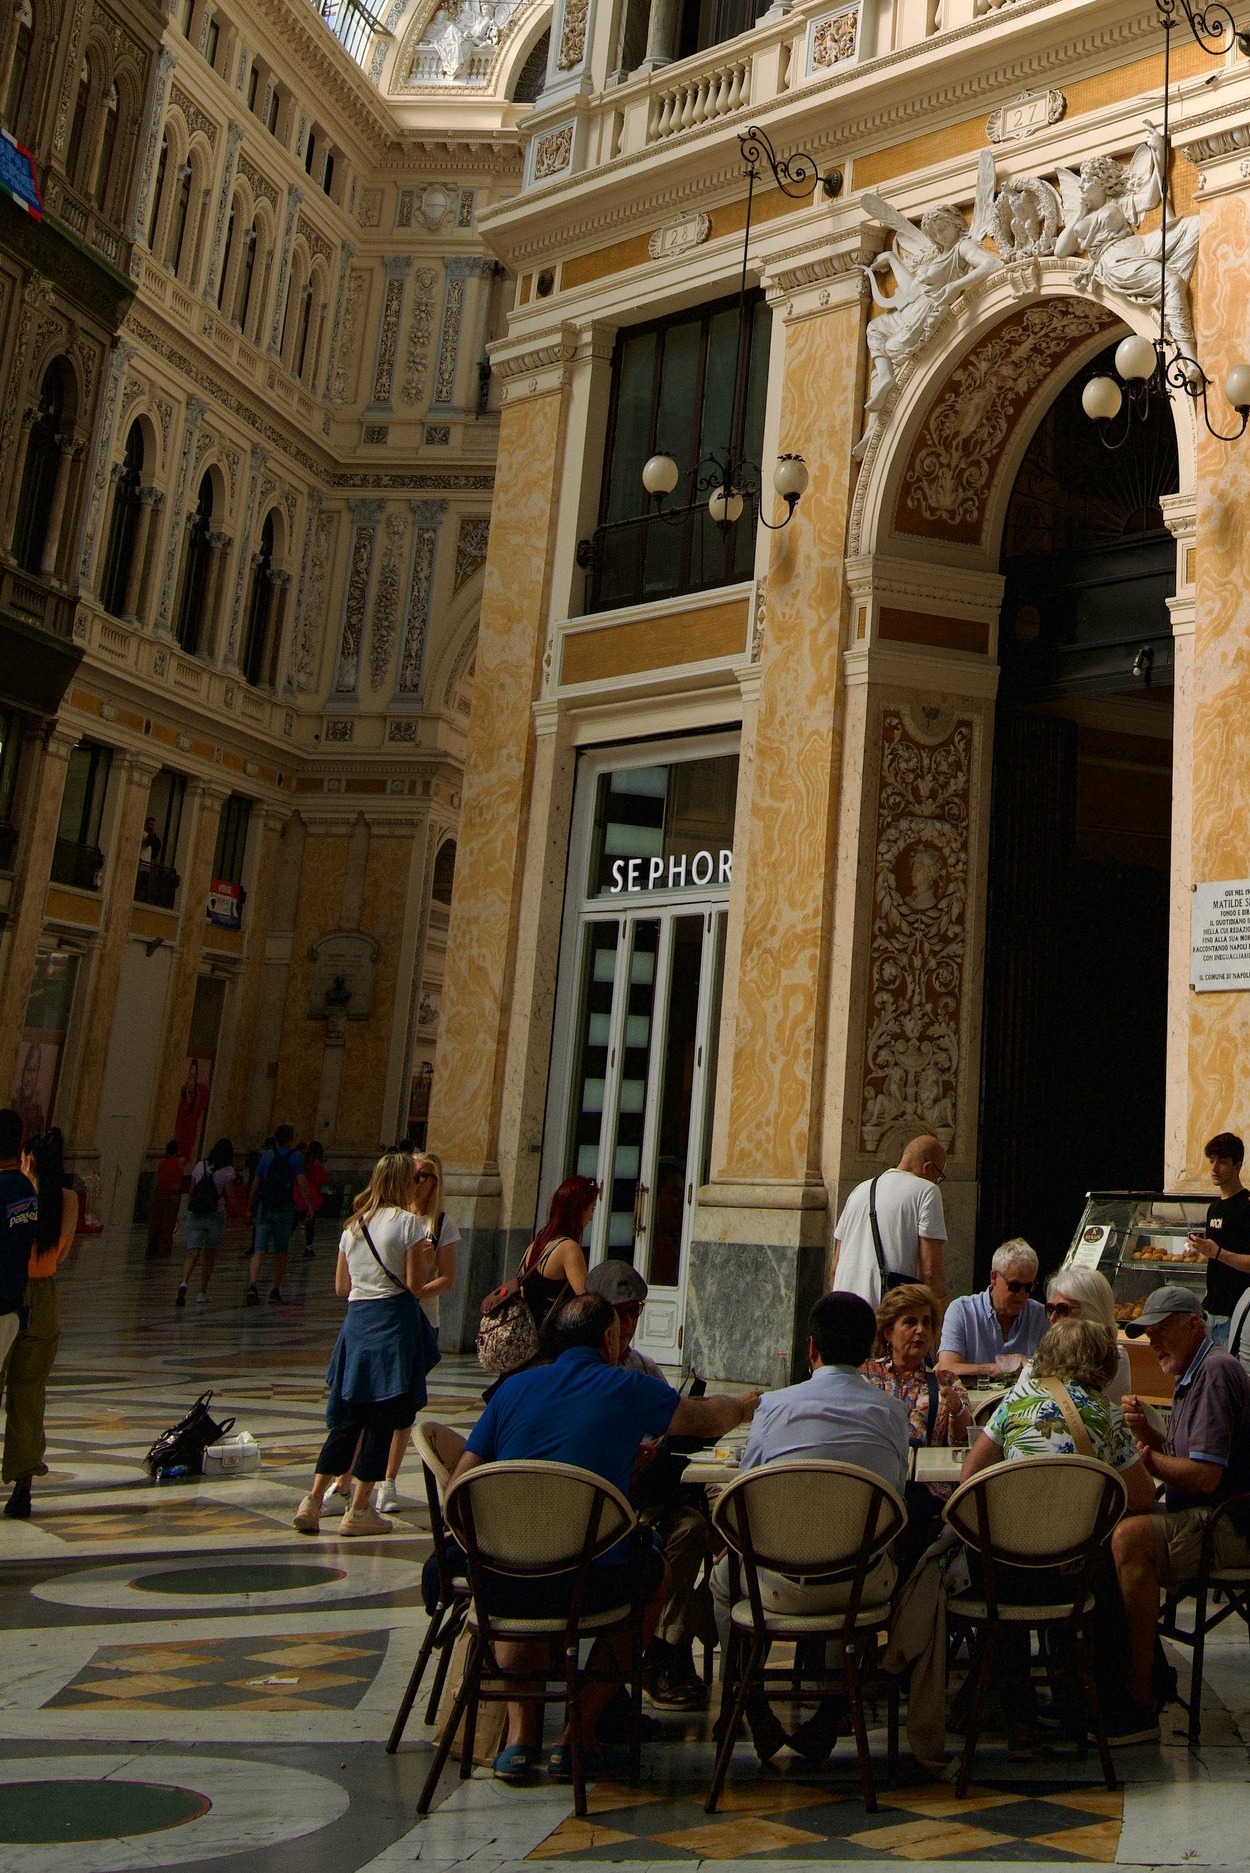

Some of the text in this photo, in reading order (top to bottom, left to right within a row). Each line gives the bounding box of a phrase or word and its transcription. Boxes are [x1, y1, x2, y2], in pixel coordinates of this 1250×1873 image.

[1014, 104, 1038, 127] 27
[670, 226, 688, 246] 28
[1213, 899, 1243, 909] MATILDE
[1216, 917, 1246, 926] QUOTIDIANO
[1193, 944, 1228, 953] RACCONTANDO
